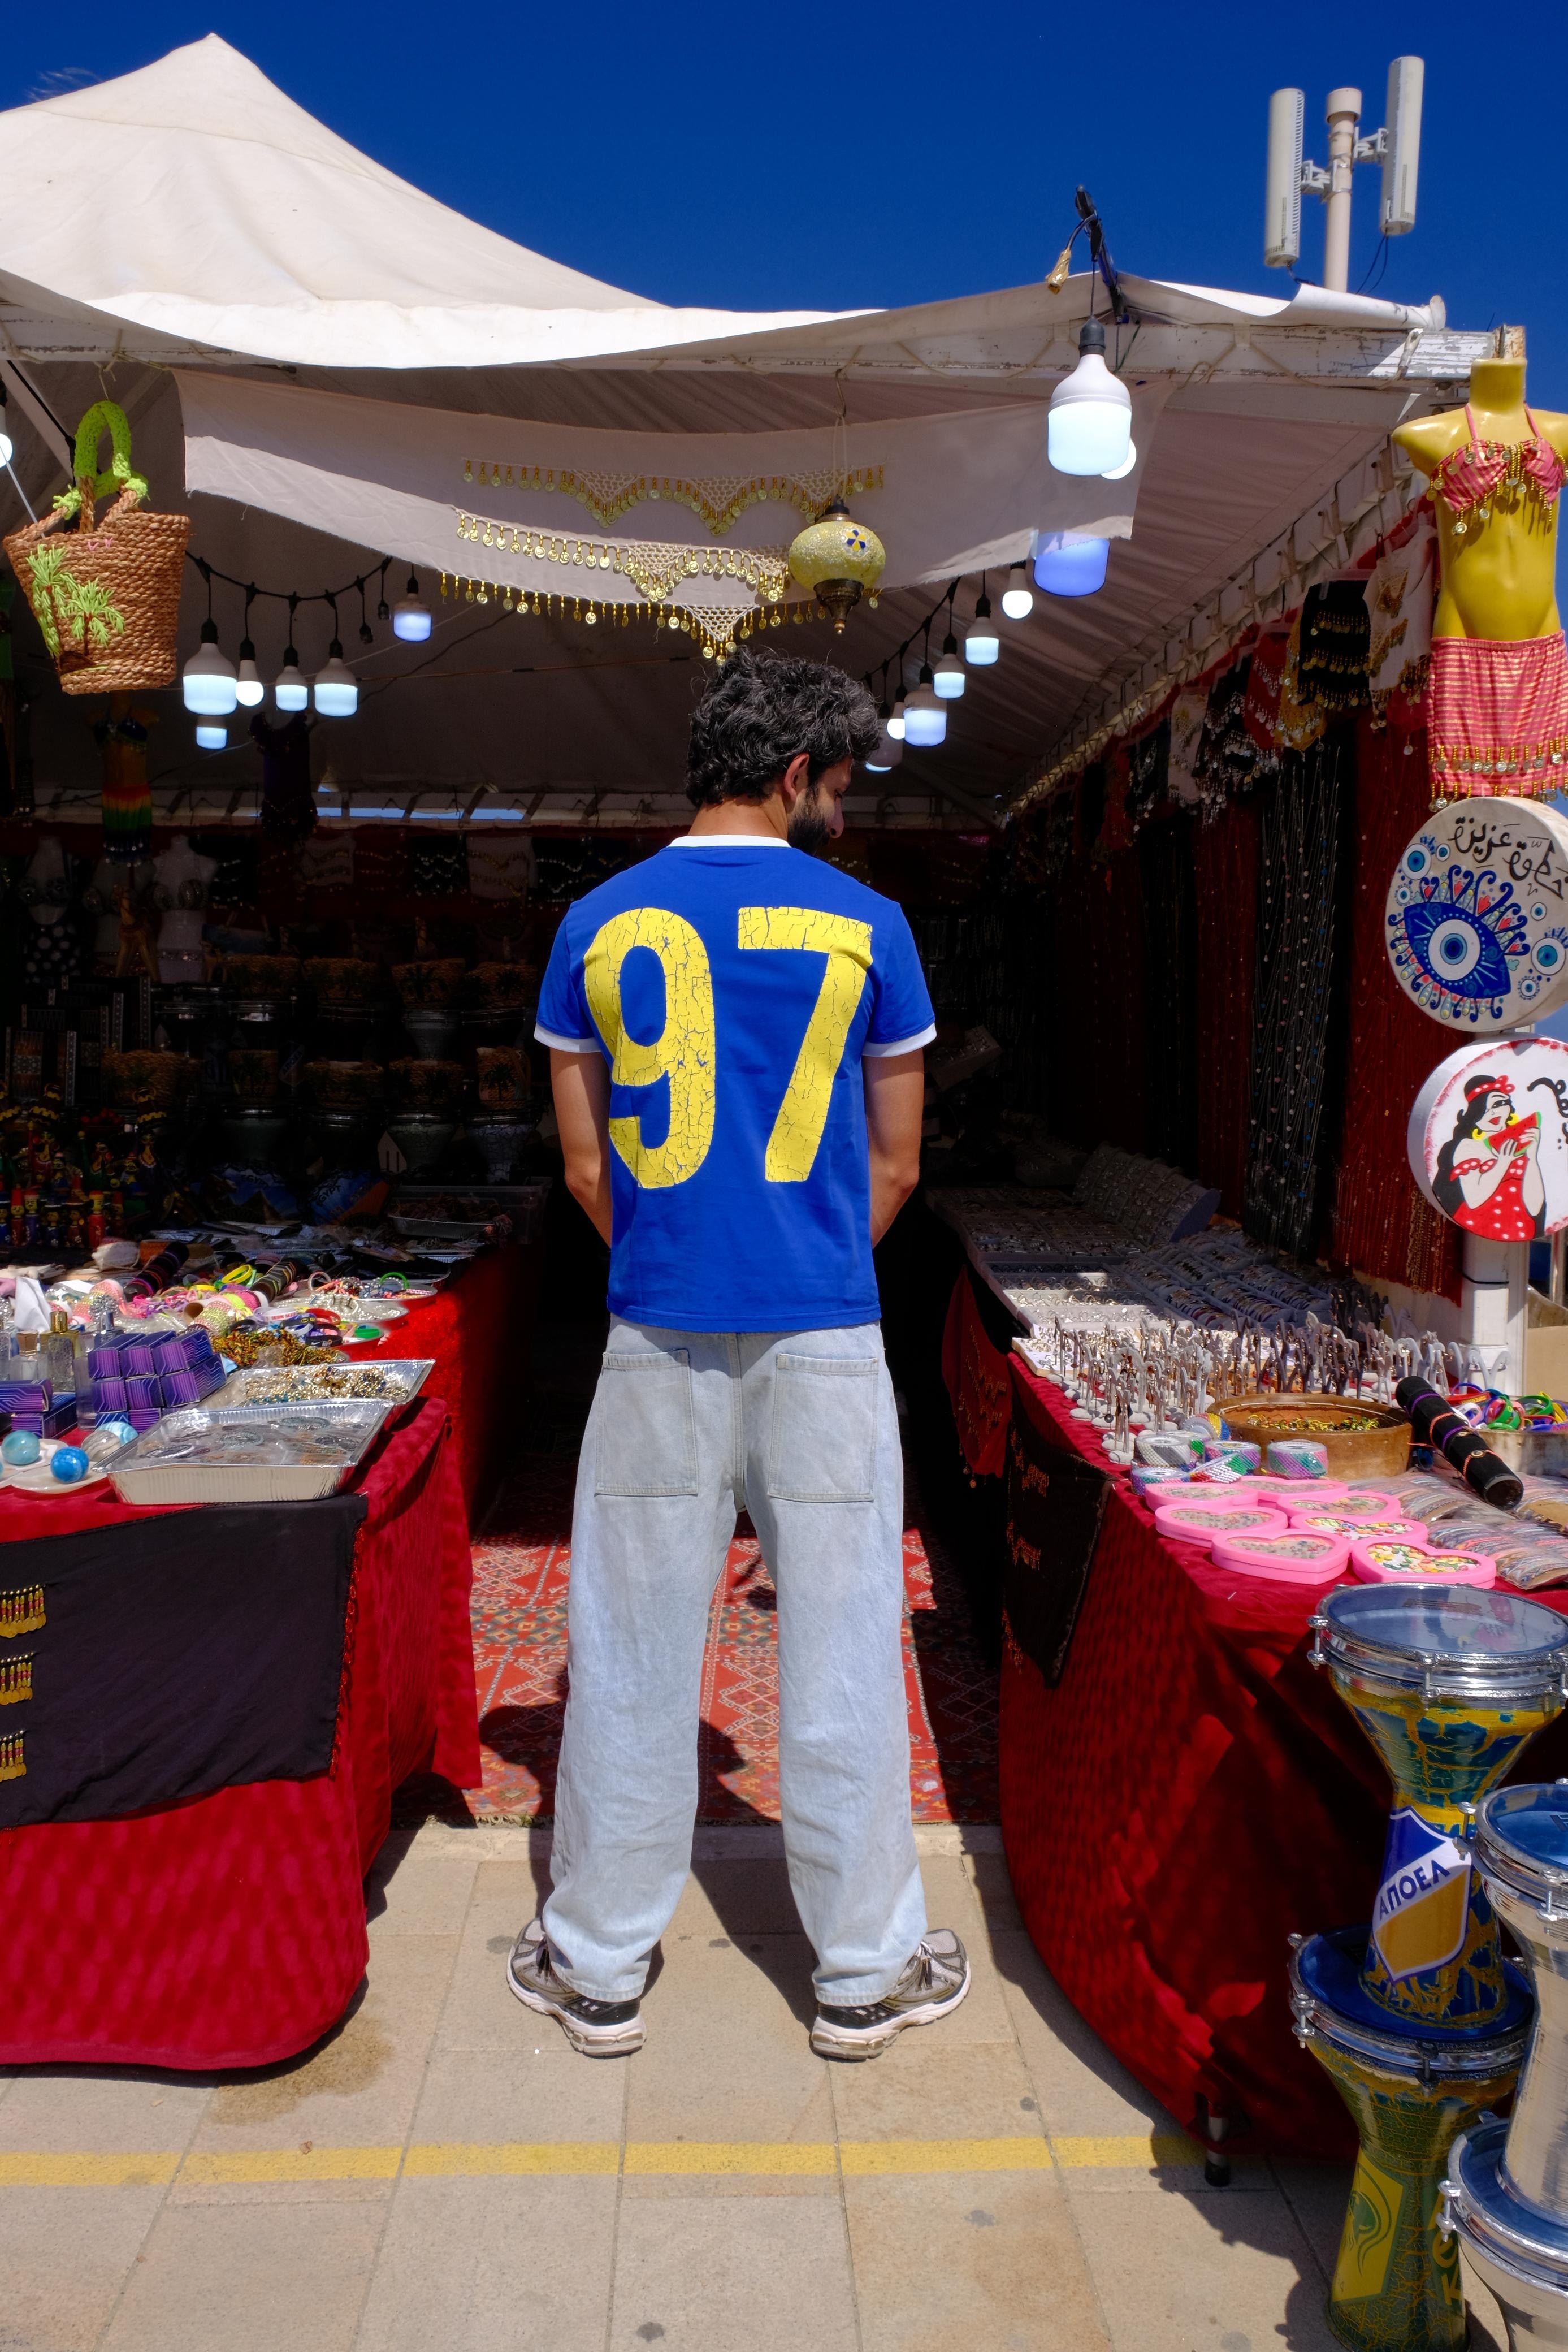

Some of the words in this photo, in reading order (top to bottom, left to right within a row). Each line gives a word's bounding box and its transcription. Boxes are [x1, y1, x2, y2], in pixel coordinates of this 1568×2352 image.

[1447, 816, 1512, 863] عزيزة
[583, 906, 873, 1188] 97
[1379, 1859, 1451, 1921] ΑΠΟΕΛ
